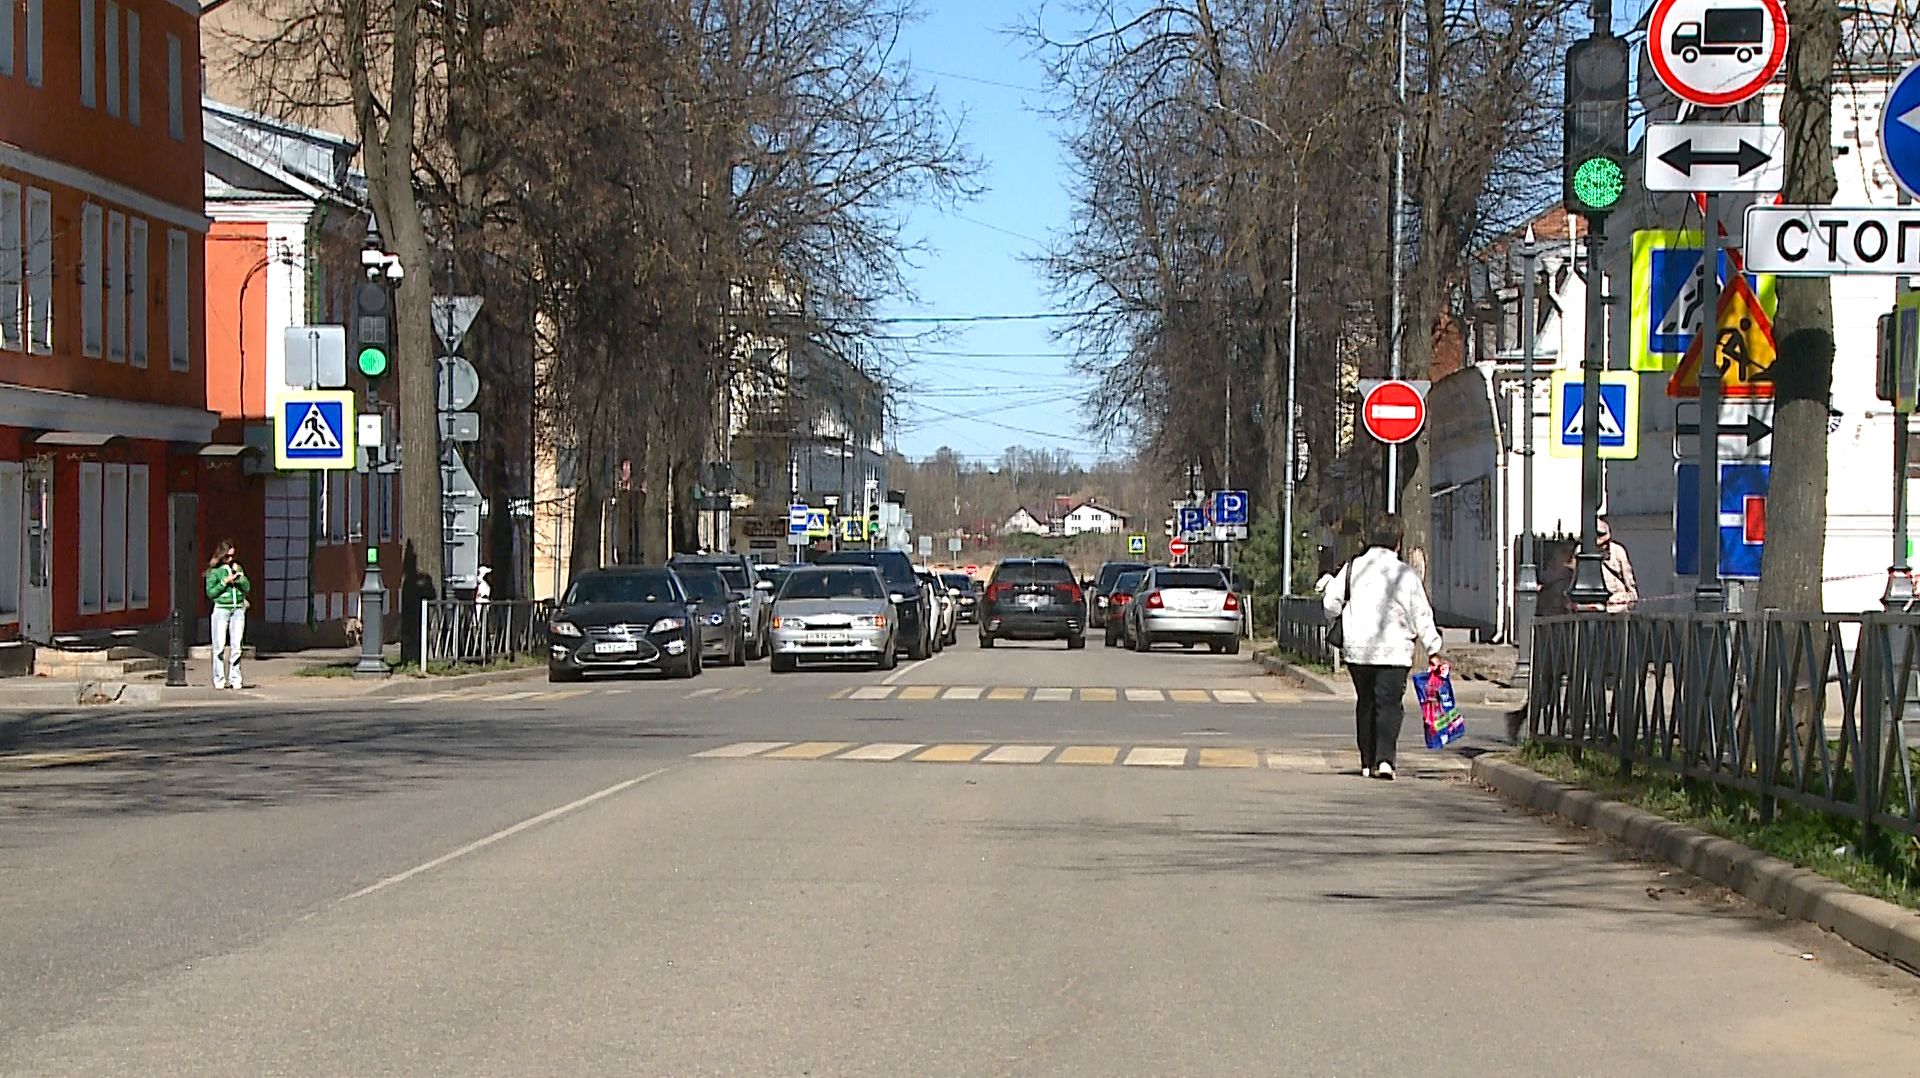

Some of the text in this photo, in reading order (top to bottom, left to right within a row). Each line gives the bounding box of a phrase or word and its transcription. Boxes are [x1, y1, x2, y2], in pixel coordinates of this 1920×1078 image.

[1776, 218, 1920, 264] СТОП
[1223, 494, 1241, 519] P
[1184, 510, 1198, 529] P
